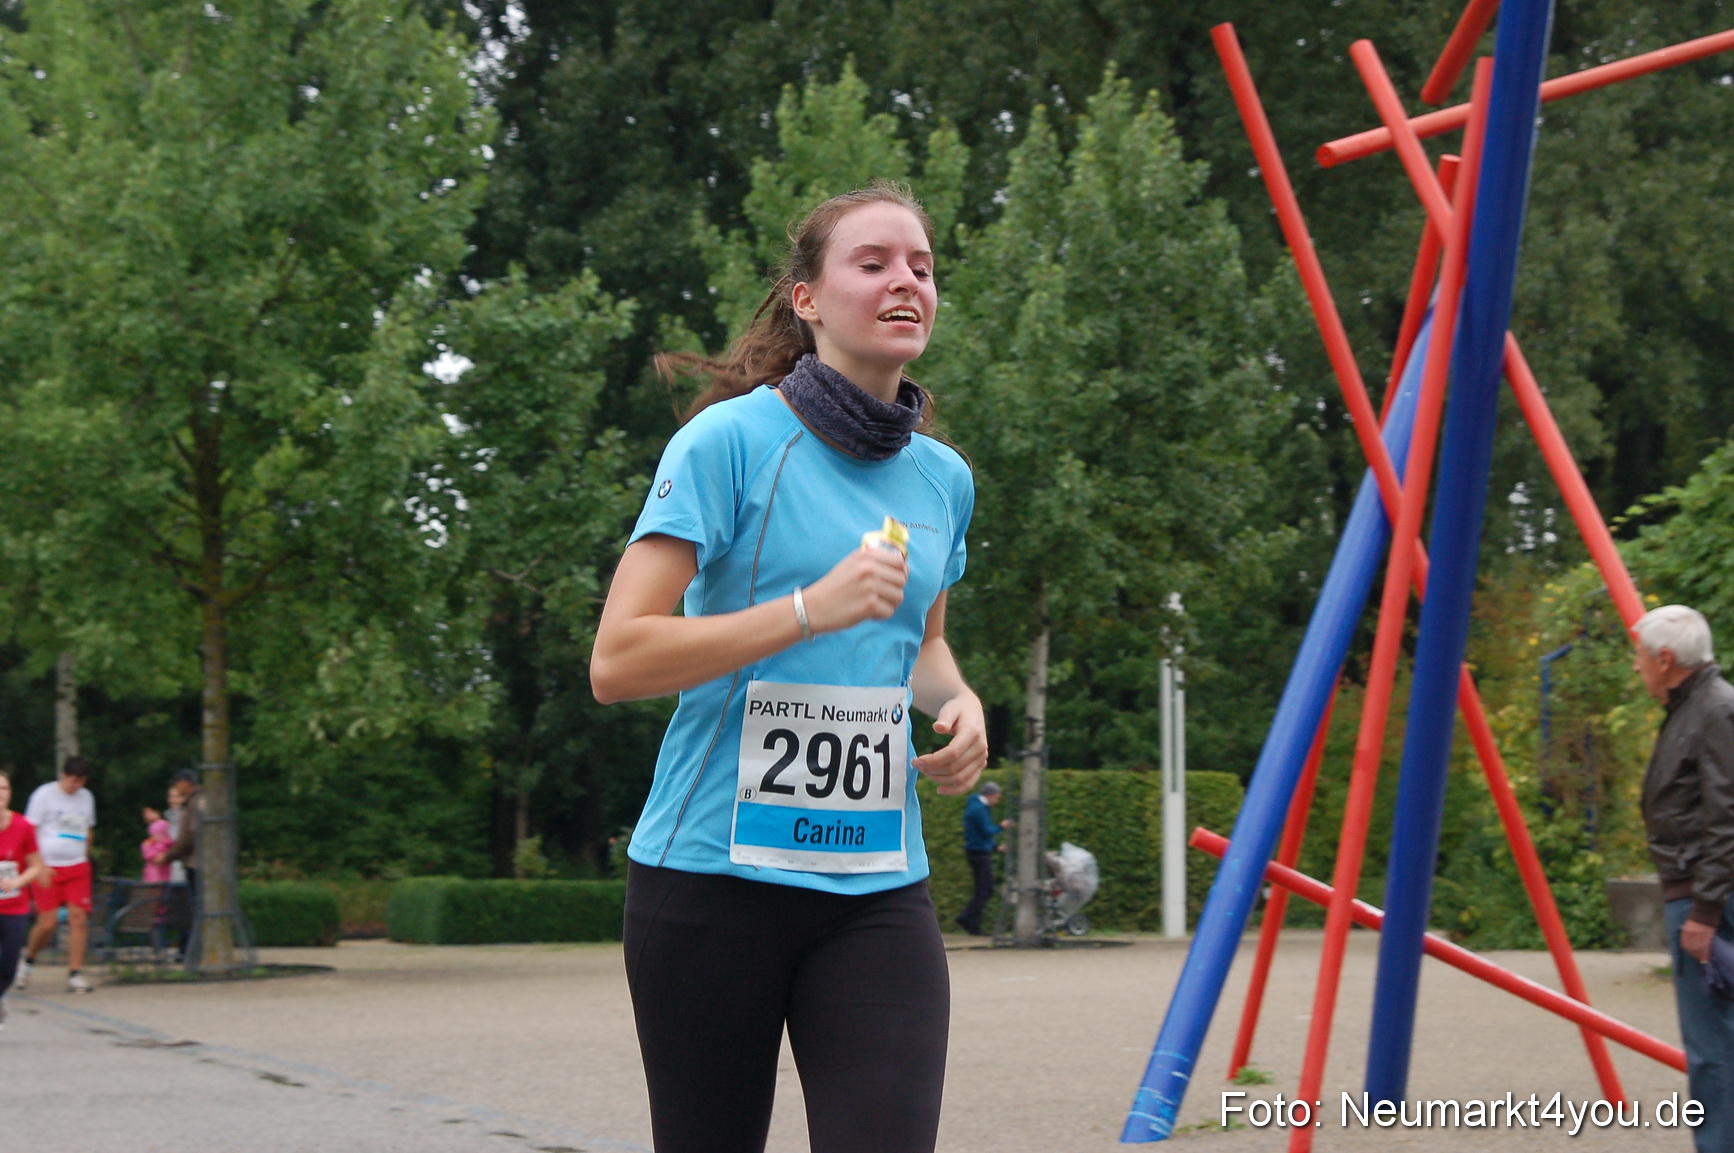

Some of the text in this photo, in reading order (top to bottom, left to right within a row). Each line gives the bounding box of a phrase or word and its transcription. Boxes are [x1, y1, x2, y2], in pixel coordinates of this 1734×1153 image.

[749, 700, 888, 723] PARTL Neumarkt
[759, 728, 891, 800] 2961
[744, 788, 752, 799] B
[793, 817, 866, 846] Carina
